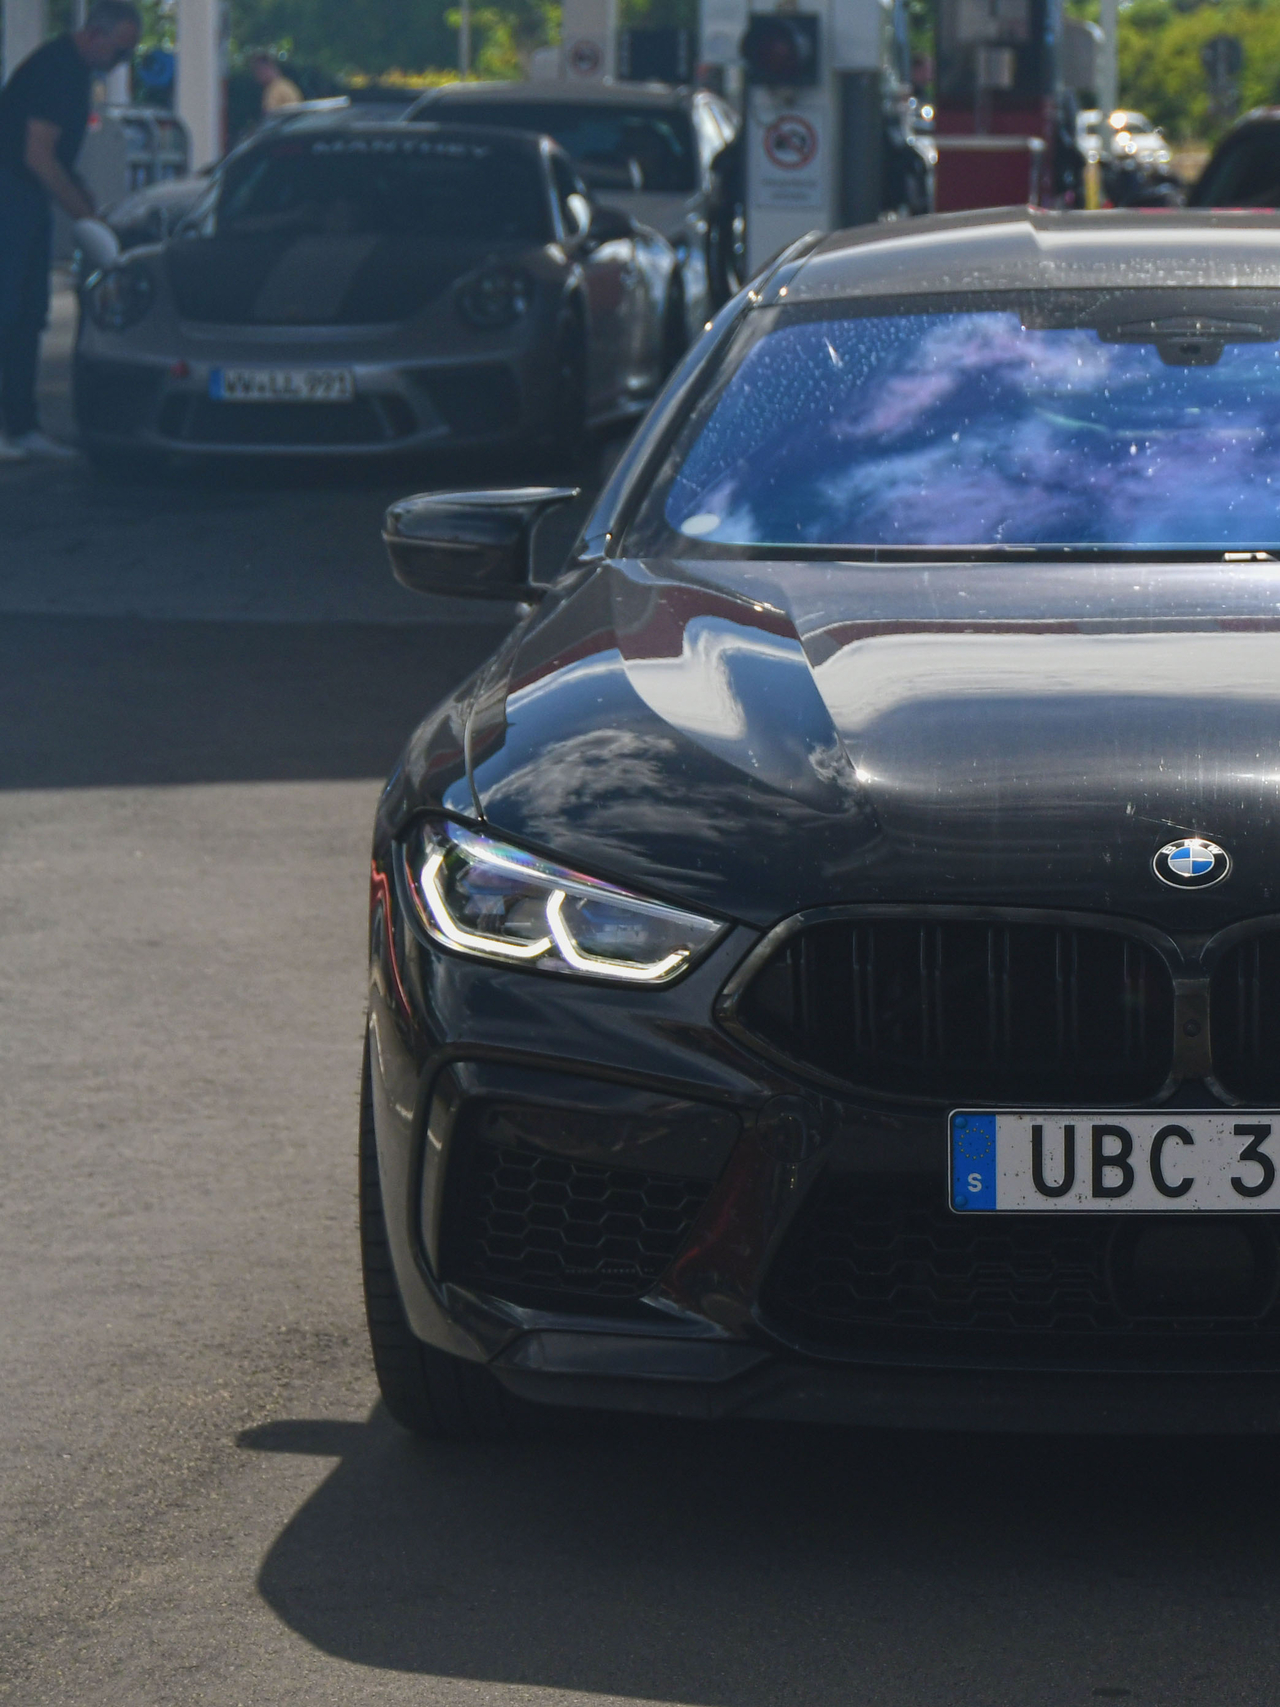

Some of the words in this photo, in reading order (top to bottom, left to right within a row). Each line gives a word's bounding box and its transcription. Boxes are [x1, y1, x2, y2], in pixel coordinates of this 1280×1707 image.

[1162, 840, 1222, 854] BMW
[1031, 1123, 1195, 1199] UBC
[967, 1172, 983, 1193] S
